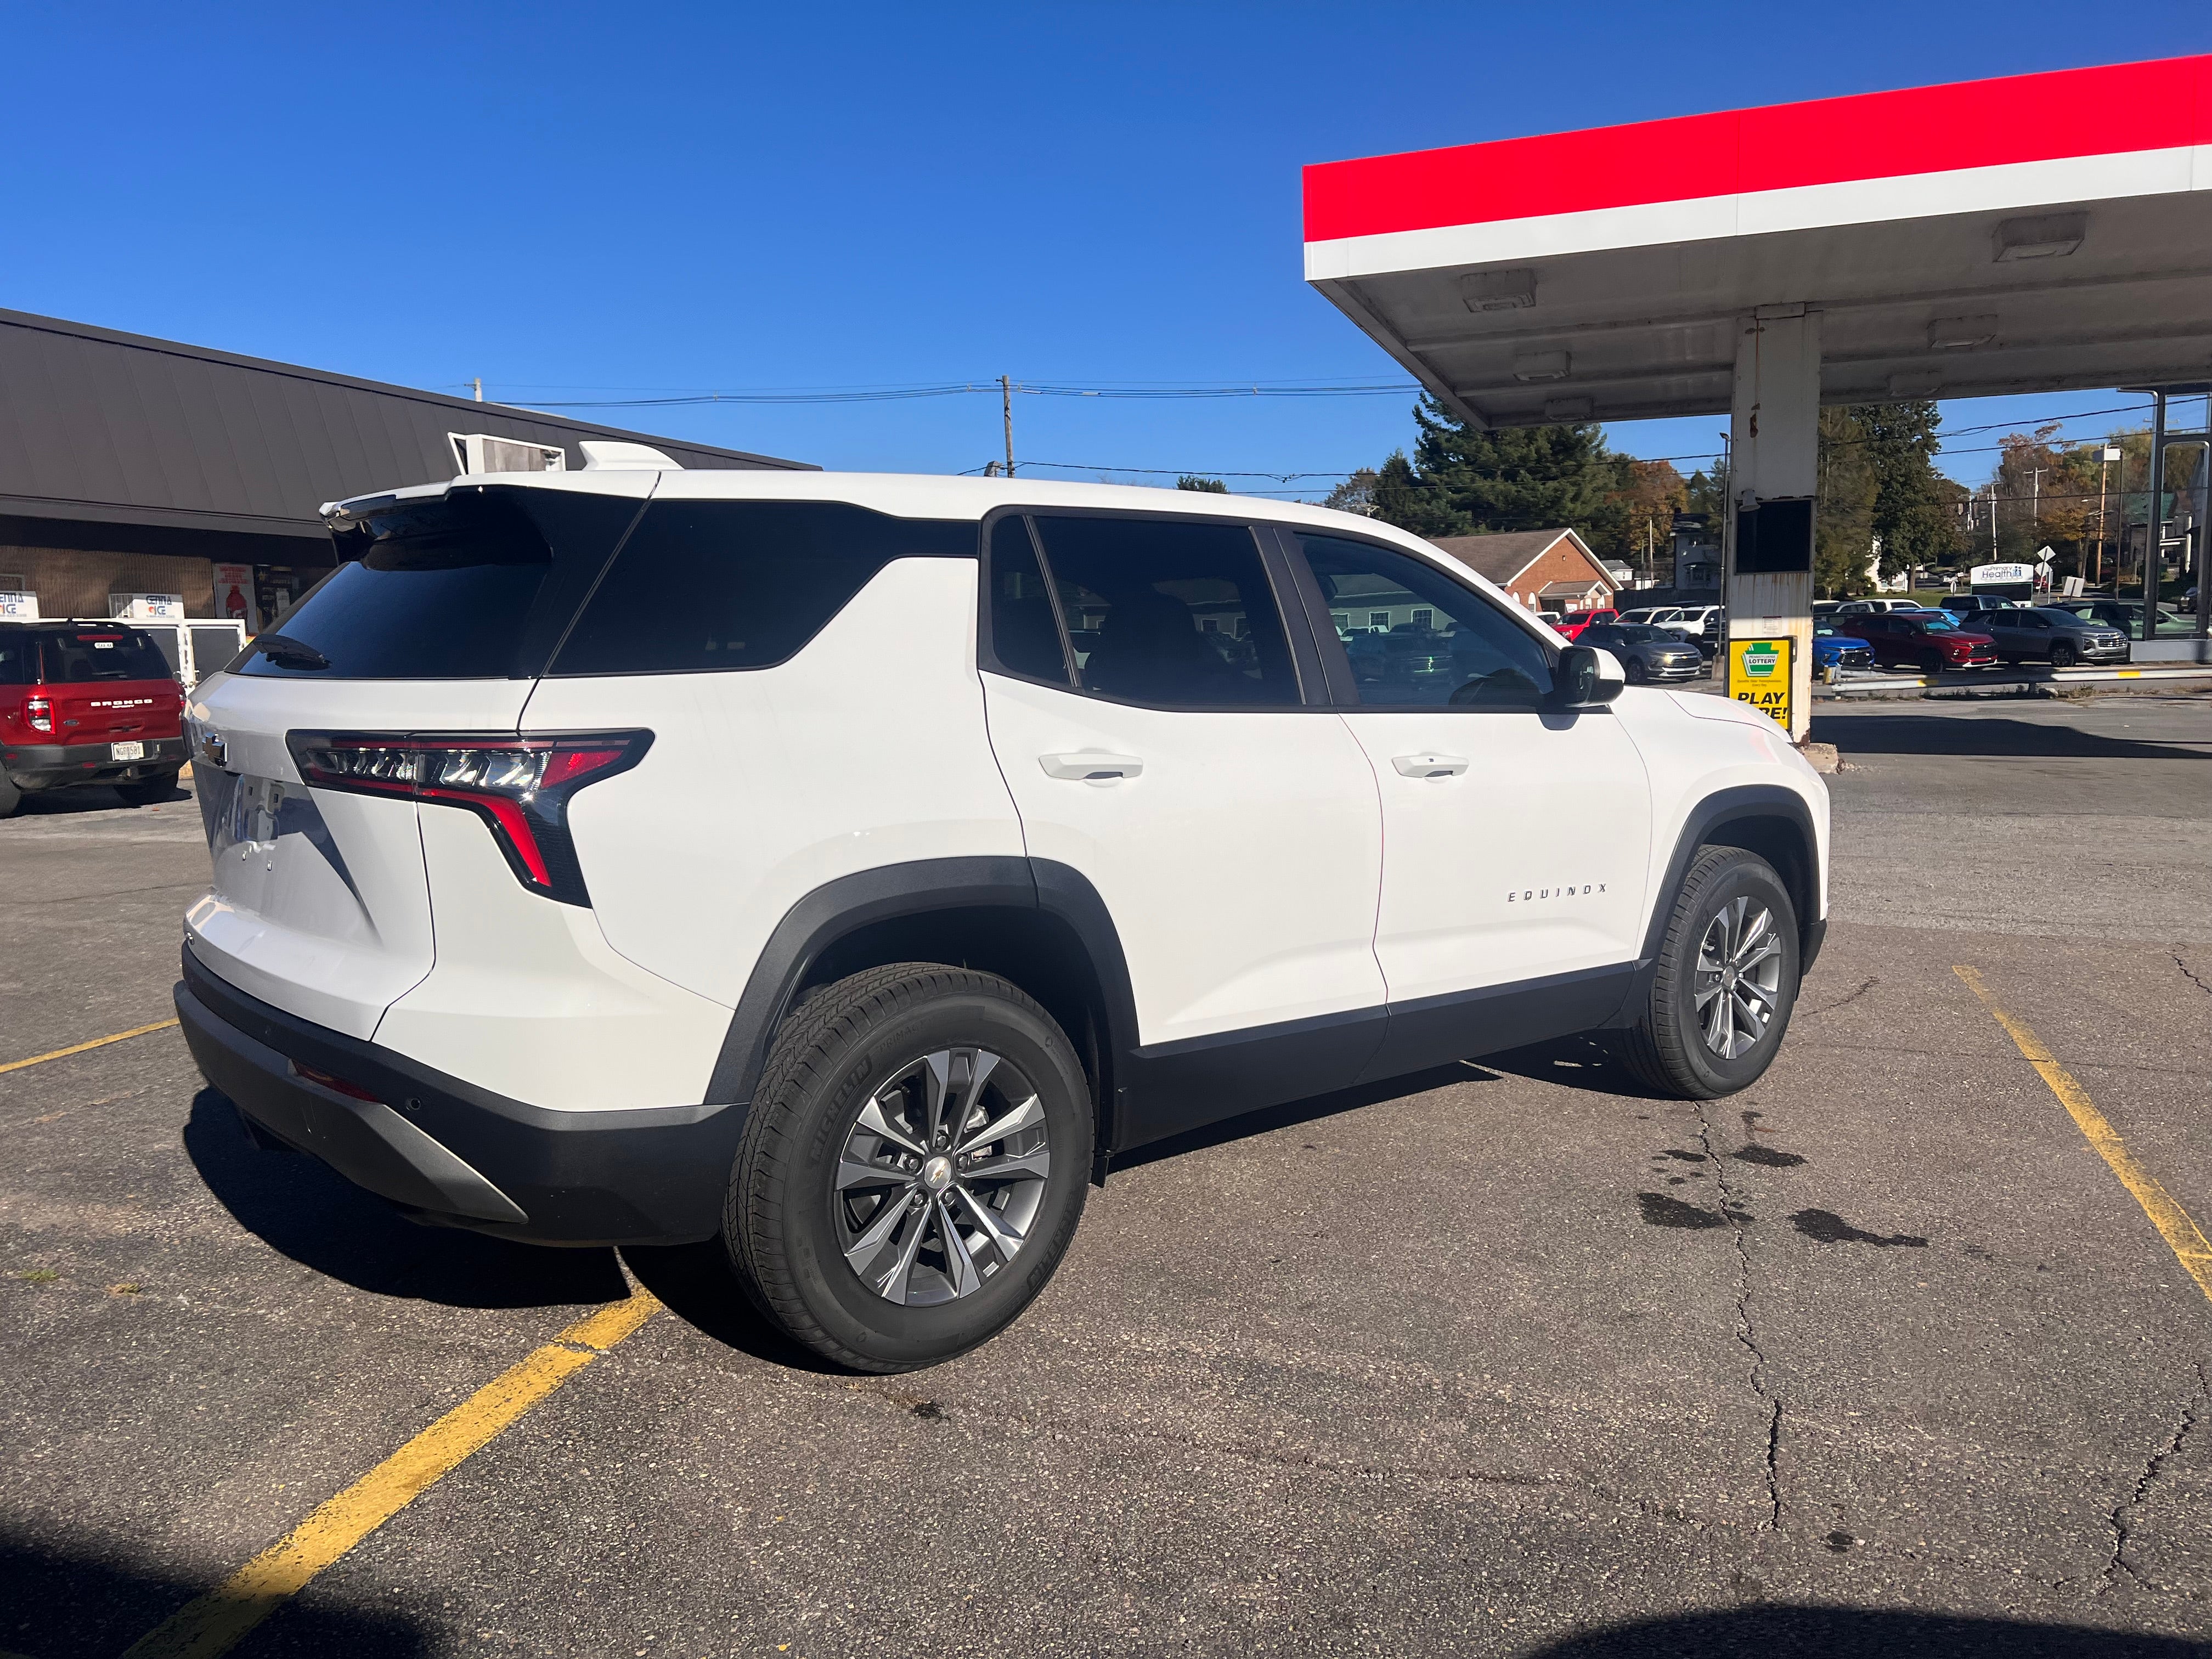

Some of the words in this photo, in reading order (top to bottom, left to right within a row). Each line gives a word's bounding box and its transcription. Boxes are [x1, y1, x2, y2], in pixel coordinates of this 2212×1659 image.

[1737, 692, 1786, 704] PLAY
[1759, 707, 1788, 719] RE!
[1507, 883, 1606, 902] EQUINOX
